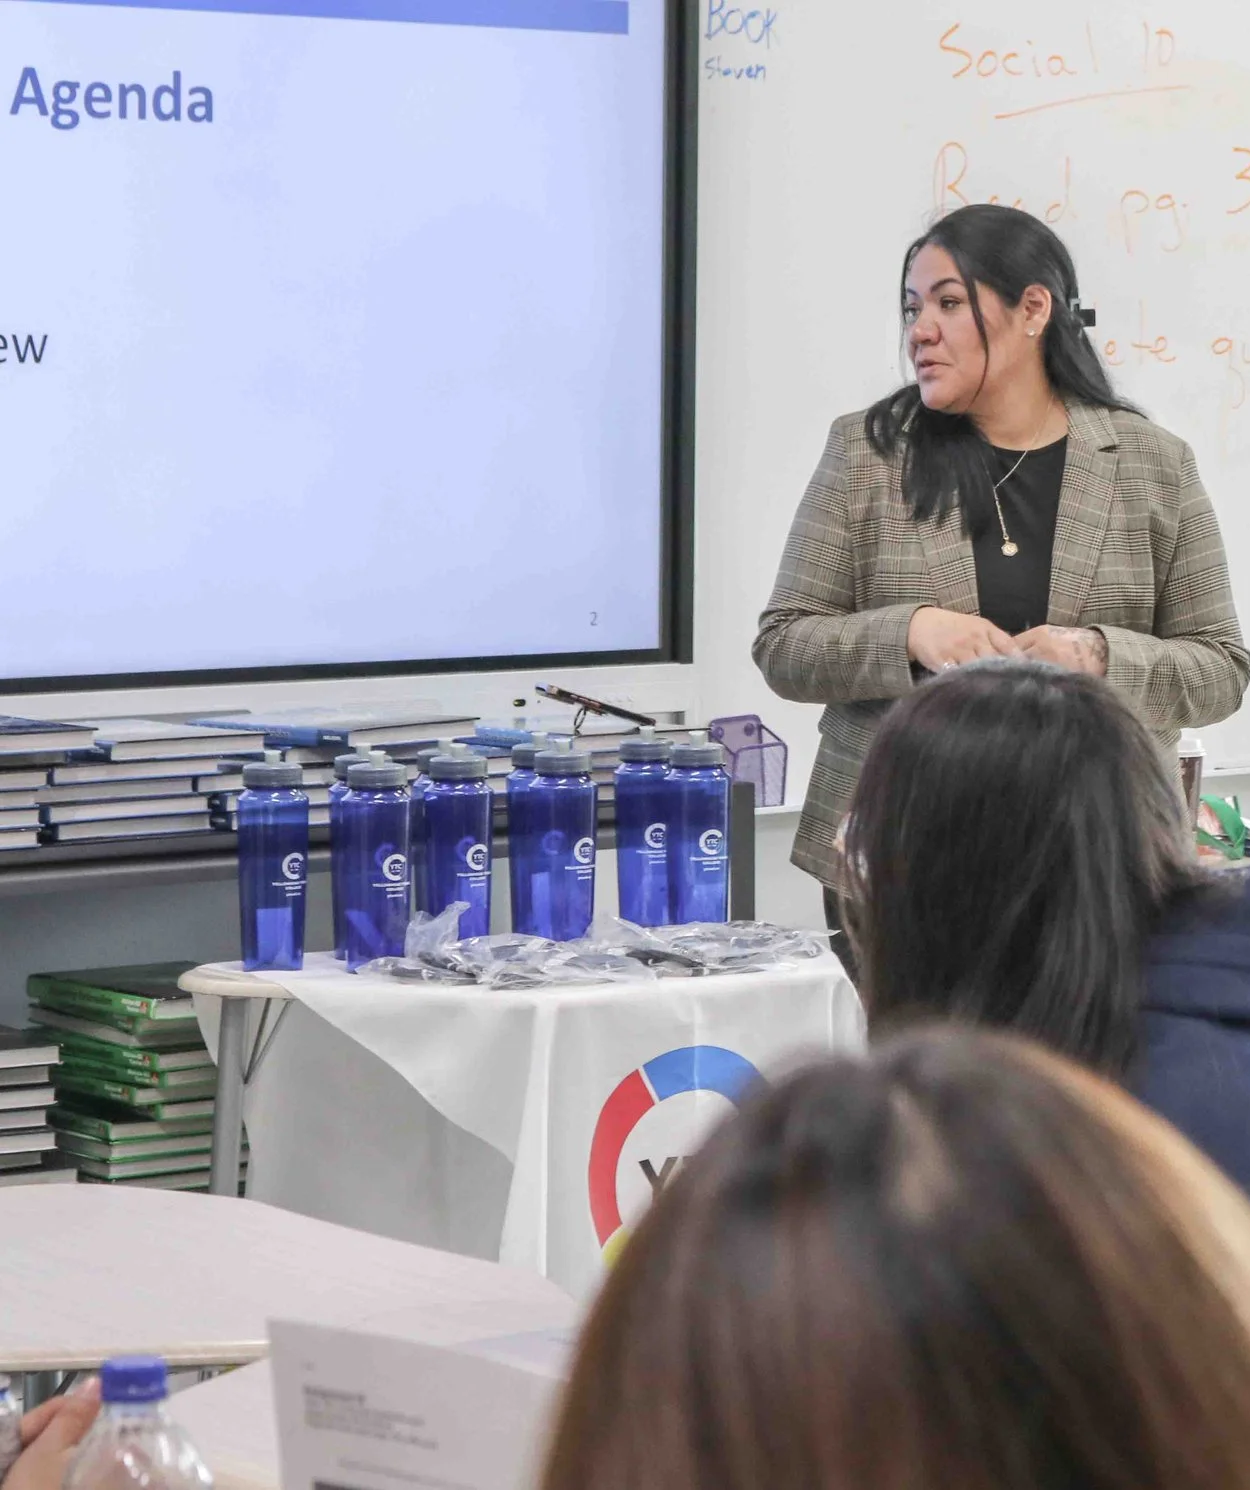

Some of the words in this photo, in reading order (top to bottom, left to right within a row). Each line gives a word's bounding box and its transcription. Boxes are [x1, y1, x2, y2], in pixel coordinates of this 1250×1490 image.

[704, 0, 778, 50] BOOK
[939, 21, 1100, 79] Social
[1143, 21, 1176, 74] 10
[9, 66, 213, 130] Agenda
[588, 611, 599, 627] 2
